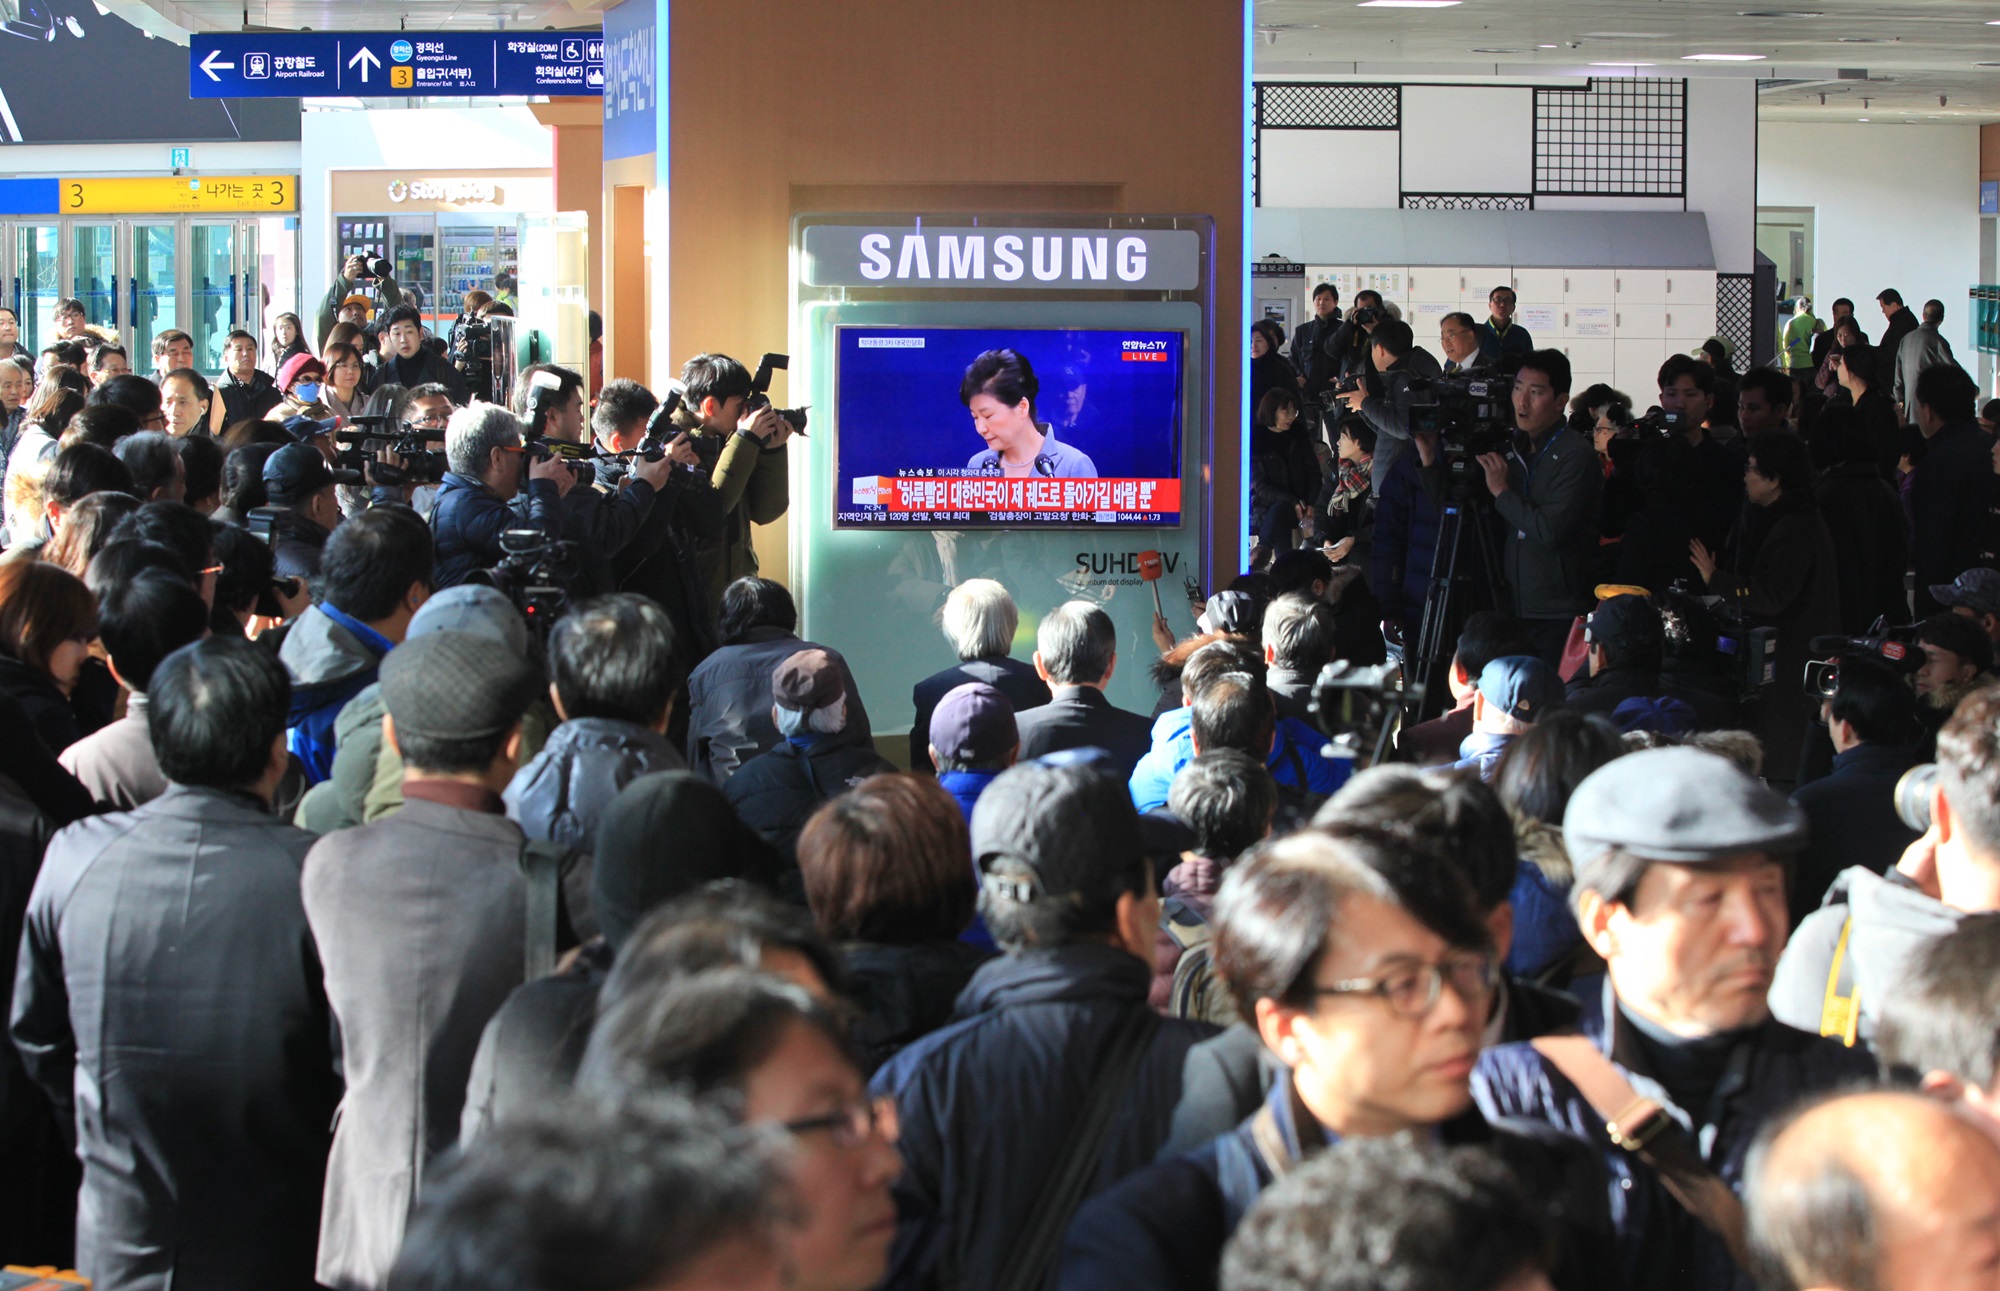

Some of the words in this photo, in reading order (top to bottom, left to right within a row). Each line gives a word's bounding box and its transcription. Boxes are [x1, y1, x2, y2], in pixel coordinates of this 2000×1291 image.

[416, 42, 444, 53] 경의선
[507, 41, 558, 53] 화장실(20M)
[274, 56, 316, 69] 공항철도
[416, 54, 444, 62] Gyeongui
[275, 71, 297, 79] Airport
[416, 68, 472, 80] 출입구(서부)
[535, 66, 584, 77] 회의실(4F)
[397, 69, 408, 86] 3
[71, 183, 84, 208] 3
[206, 183, 244, 198] 나가는
[252, 183, 264, 198] 곳
[270, 181, 284, 205] 3
[860, 233, 1147, 281] SAMSUNG
[895, 339, 923, 347] 대국민담화
[1122, 340, 1167, 350] 연합뉴스TV
[1132, 352, 1158, 361] LIVE
[1469, 385, 1487, 393] OBS
[937, 468, 945, 477] 이
[945, 468, 960, 477] 시각
[960, 468, 980, 477] 청와대
[981, 468, 1001, 477] 춘추관
[897, 480, 948, 509] "하루빨리
[951, 480, 1009, 509] 대한민국이
[1011, 481, 1024, 509] 제
[1026, 481, 1062, 508] 궤도로
[1063, 481, 1111, 509] 돌아가길
[1113, 481, 1138, 509] 바랄
[1139, 481, 1157, 509] 뿐"
[838, 512, 872, 521] 지역인재
[874, 512, 886, 521] 7급
[889, 512, 909, 521] 120명
[912, 512, 931, 522] 선발,
[934, 512, 951, 521] 역대
[953, 512, 970, 521] 최대
[987, 511, 1032, 521] '검찰총장이
[1034, 511, 1070, 521] 고발요청'
[1148, 513, 1161, 521] 1.73
[1120, 578, 1144, 587] display
